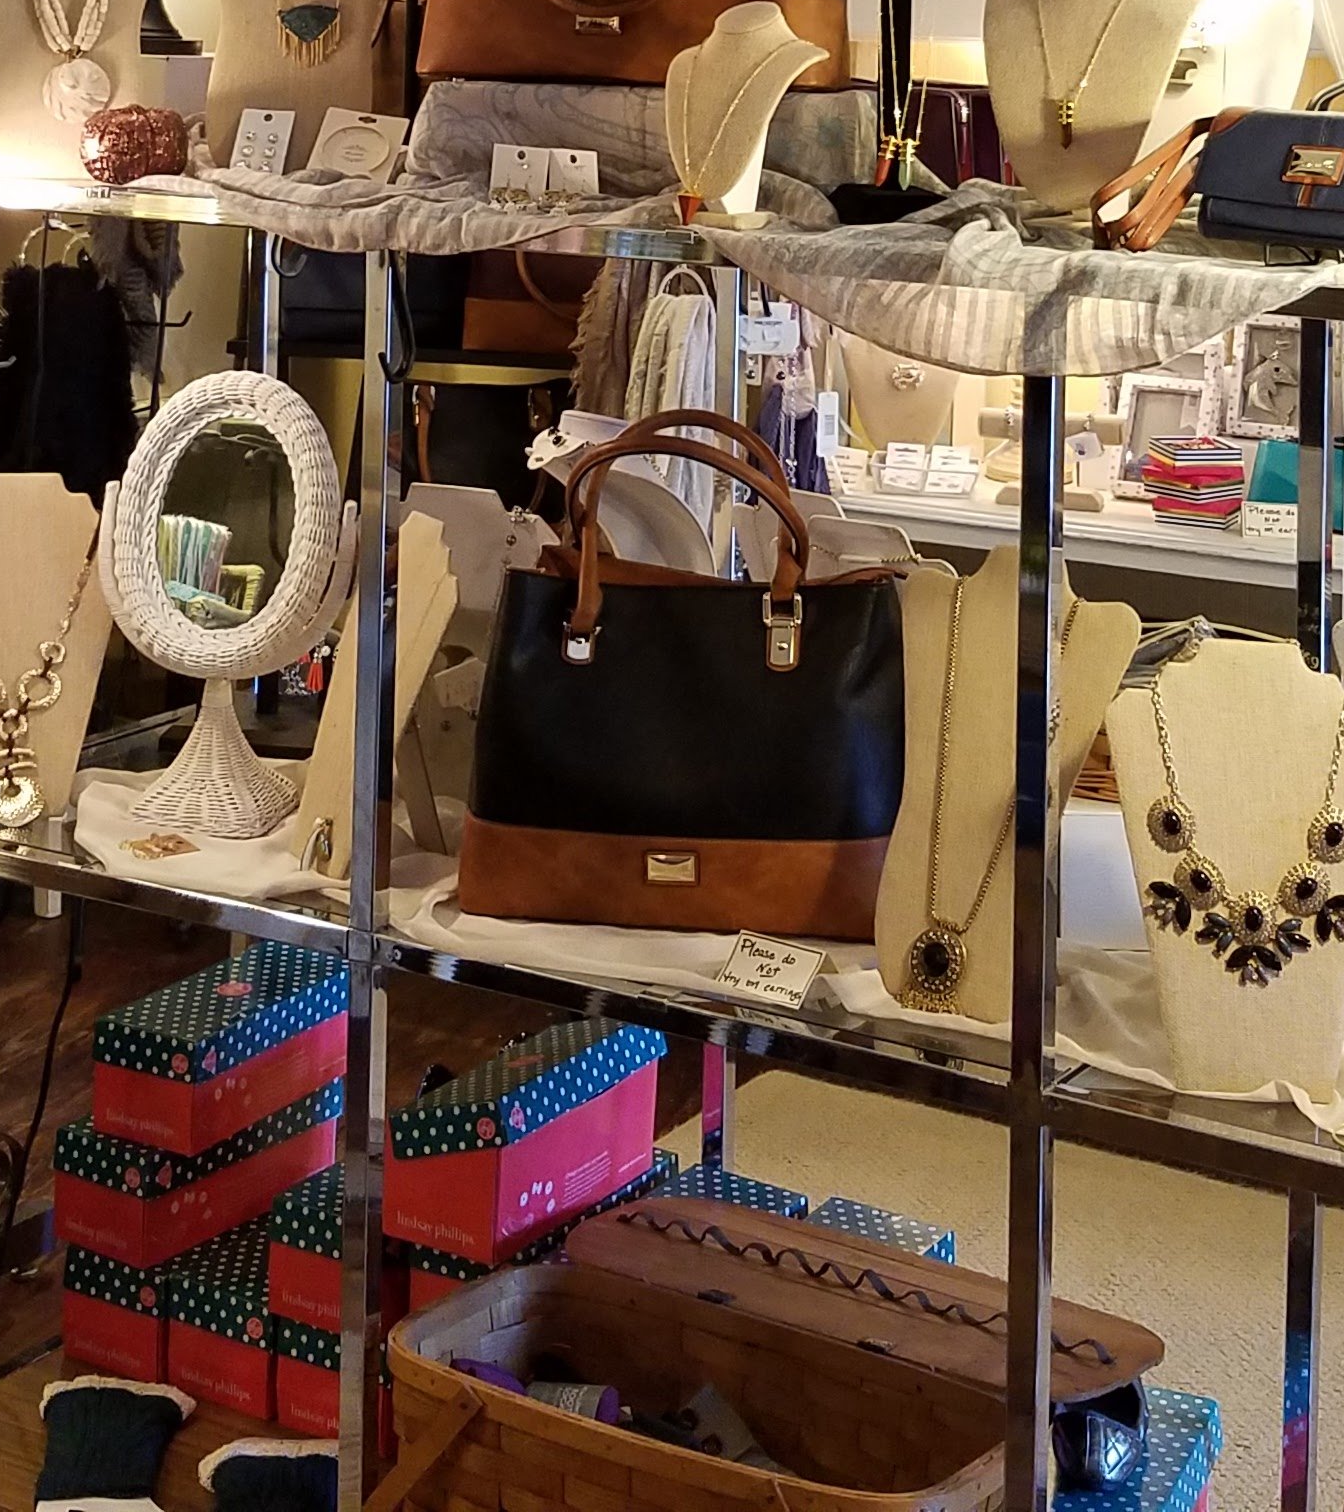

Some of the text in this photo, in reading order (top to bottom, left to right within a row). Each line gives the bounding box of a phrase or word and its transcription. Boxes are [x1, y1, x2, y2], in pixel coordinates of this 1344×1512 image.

[741, 939, 796, 965] Please do
[397, 1210, 475, 1248] lindsay phillips
[181, 1369, 251, 1401] lindsay phillips
